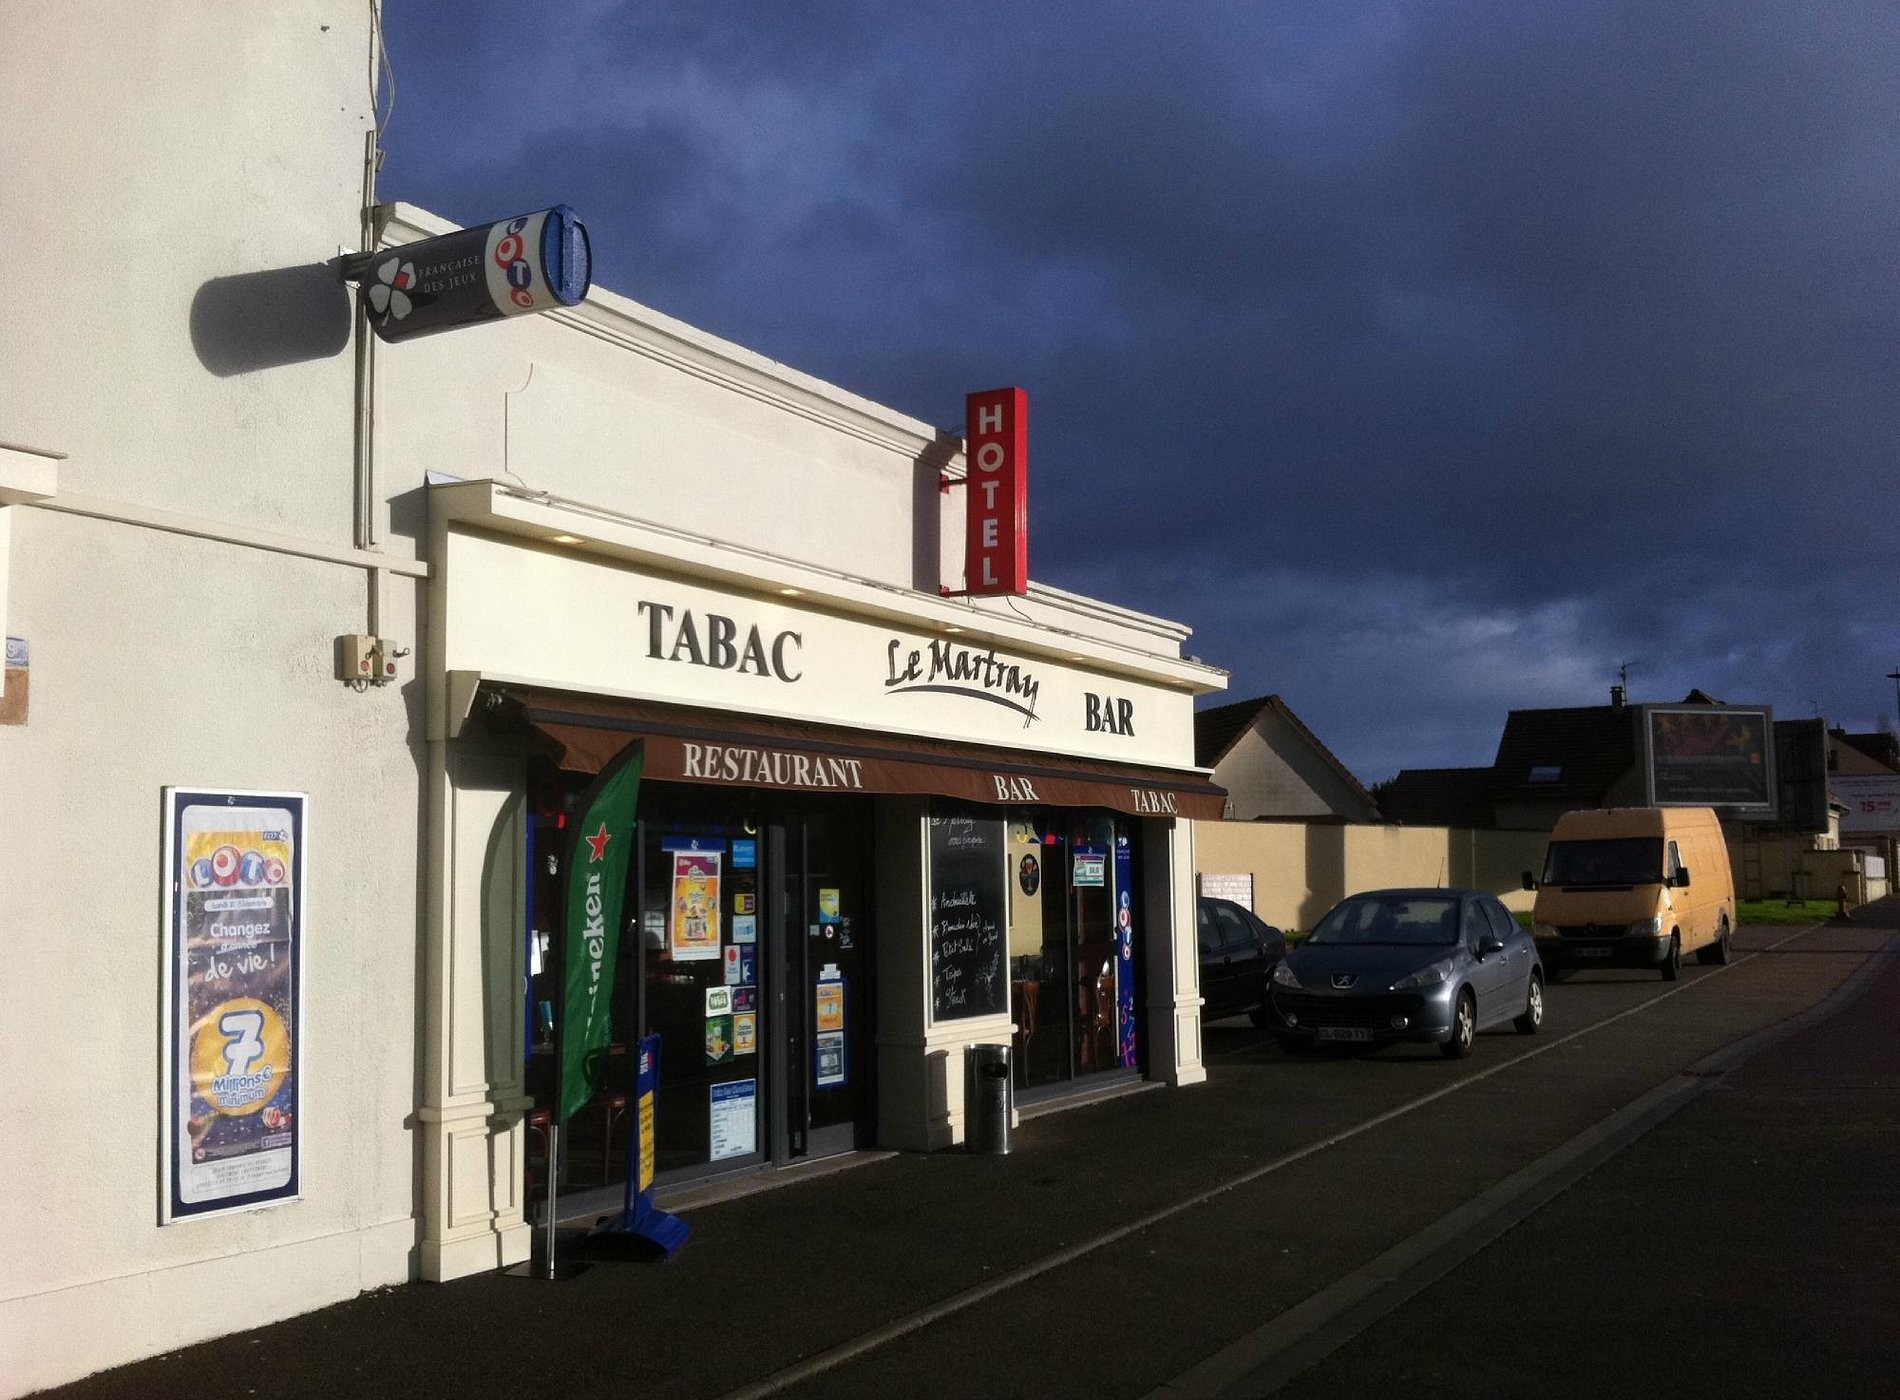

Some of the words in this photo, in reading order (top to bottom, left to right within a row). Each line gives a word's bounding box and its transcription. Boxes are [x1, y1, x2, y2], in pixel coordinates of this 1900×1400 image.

[423, 280, 445, 293] DES
[449, 272, 477, 290] JEUX
[977, 404, 1004, 585] HOTEL
[638, 601, 802, 683] TABAC
[885, 639, 923, 686] Le
[928, 638, 1039, 729] Martray
[1085, 692, 1135, 737] BAR
[683, 743, 862, 789] RESTAURANT
[994, 775, 1039, 801] BAR
[1131, 788, 1178, 815] TABAC
[190, 845, 286, 888] LOTO
[210, 922, 271, 938] Changez
[205, 955, 234, 982] de
[237, 951, 268, 975] vie
[219, 1009, 265, 1077] 7
[212, 1073, 262, 1093] Millions
